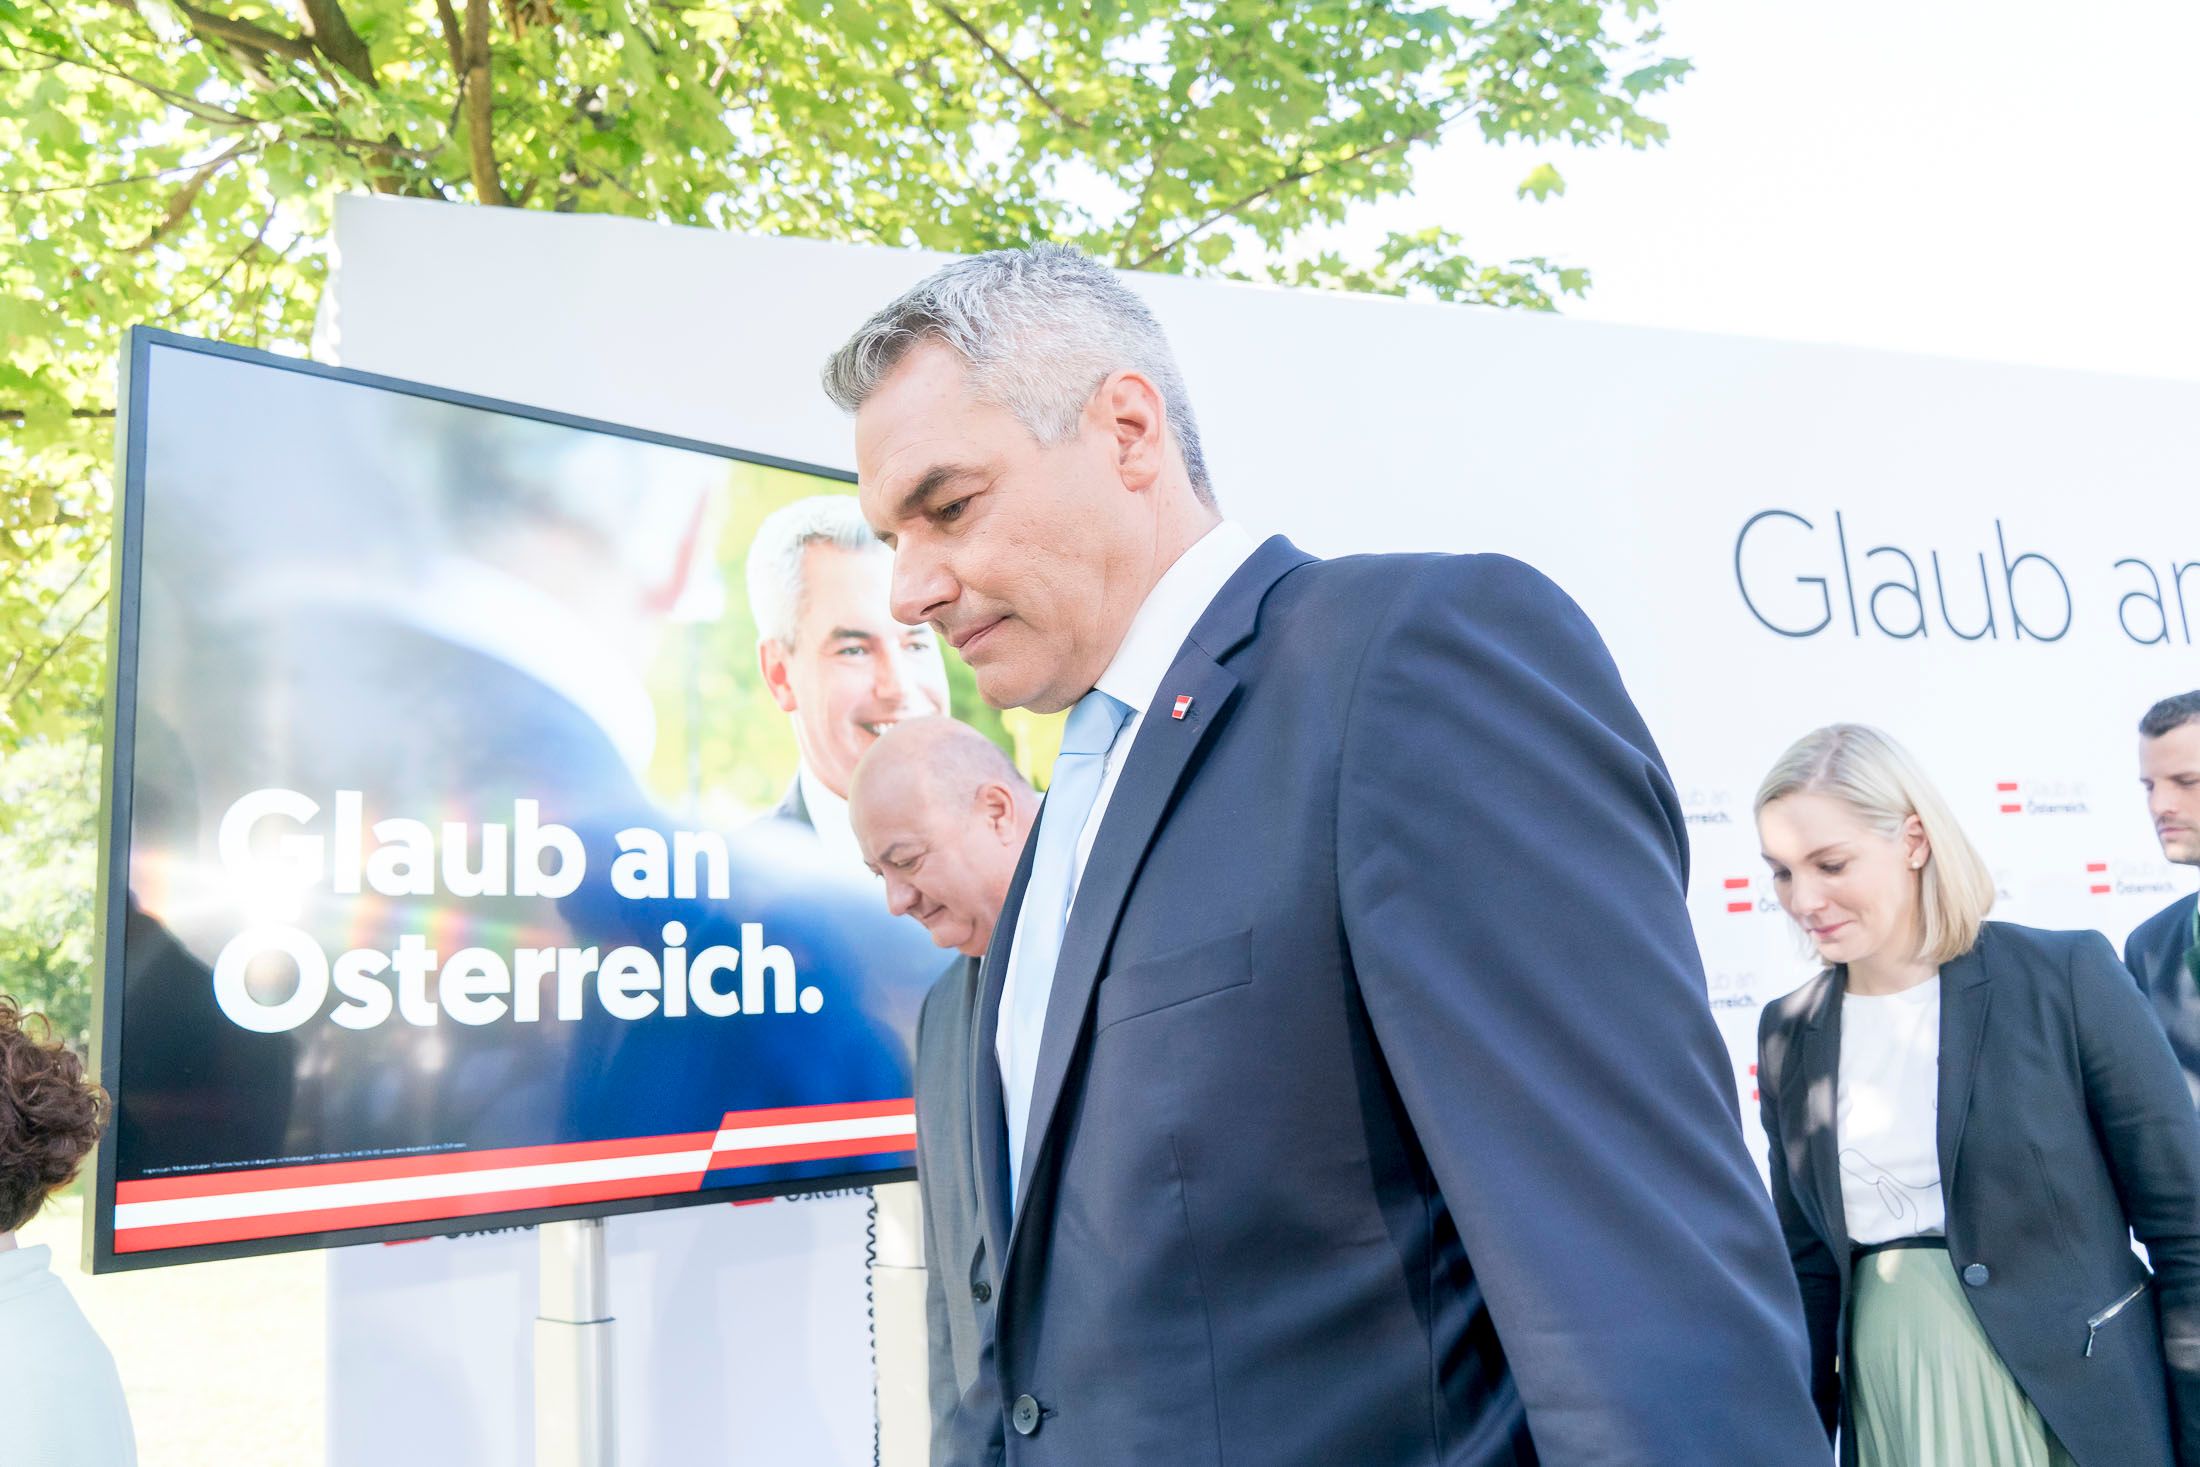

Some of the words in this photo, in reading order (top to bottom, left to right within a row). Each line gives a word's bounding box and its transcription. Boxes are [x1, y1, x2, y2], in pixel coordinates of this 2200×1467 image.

[1734, 508, 2072, 643] Glaub
[218, 787, 587, 898] Glaub
[610, 827, 730, 900] an
